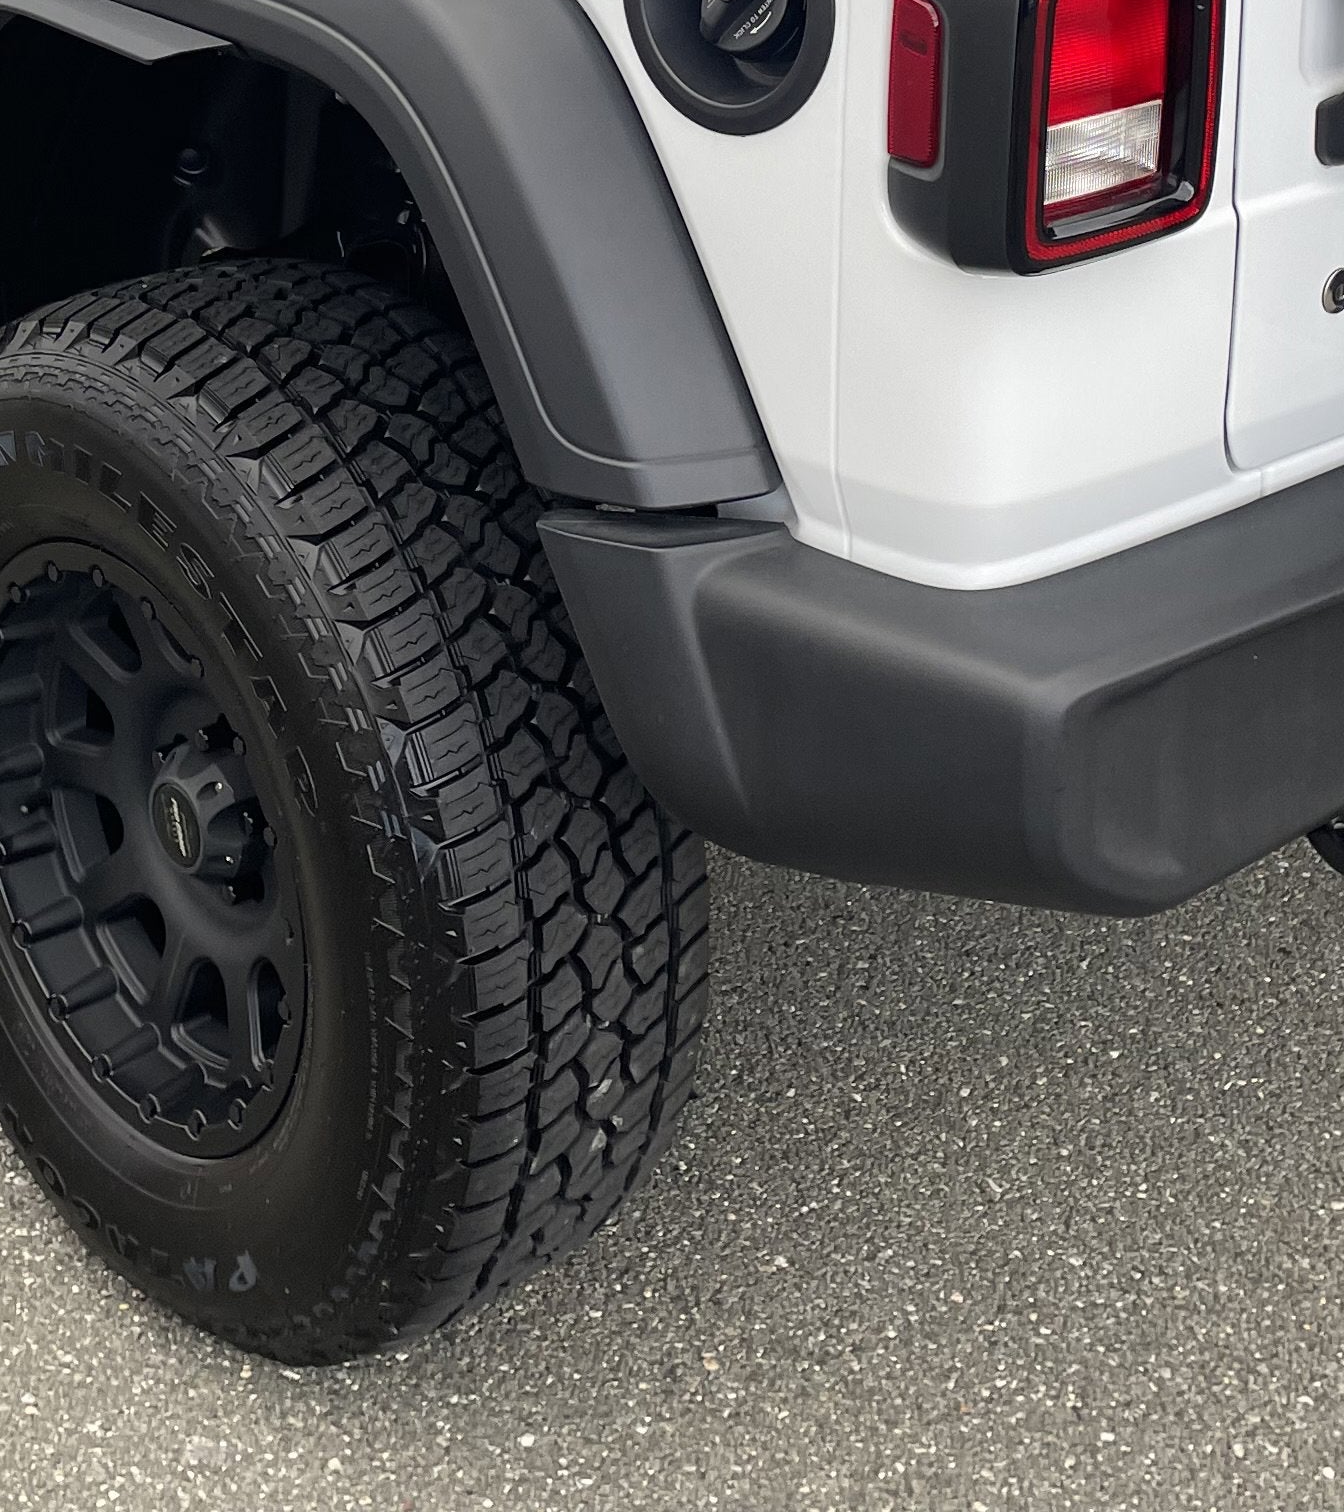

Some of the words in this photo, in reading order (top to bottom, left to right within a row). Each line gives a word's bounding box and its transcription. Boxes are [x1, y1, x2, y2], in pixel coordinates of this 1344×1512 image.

[750, 13, 759, 23] TO
[733, 21, 751, 39] CLICK
[24, 431, 318, 818] MILESTAR
